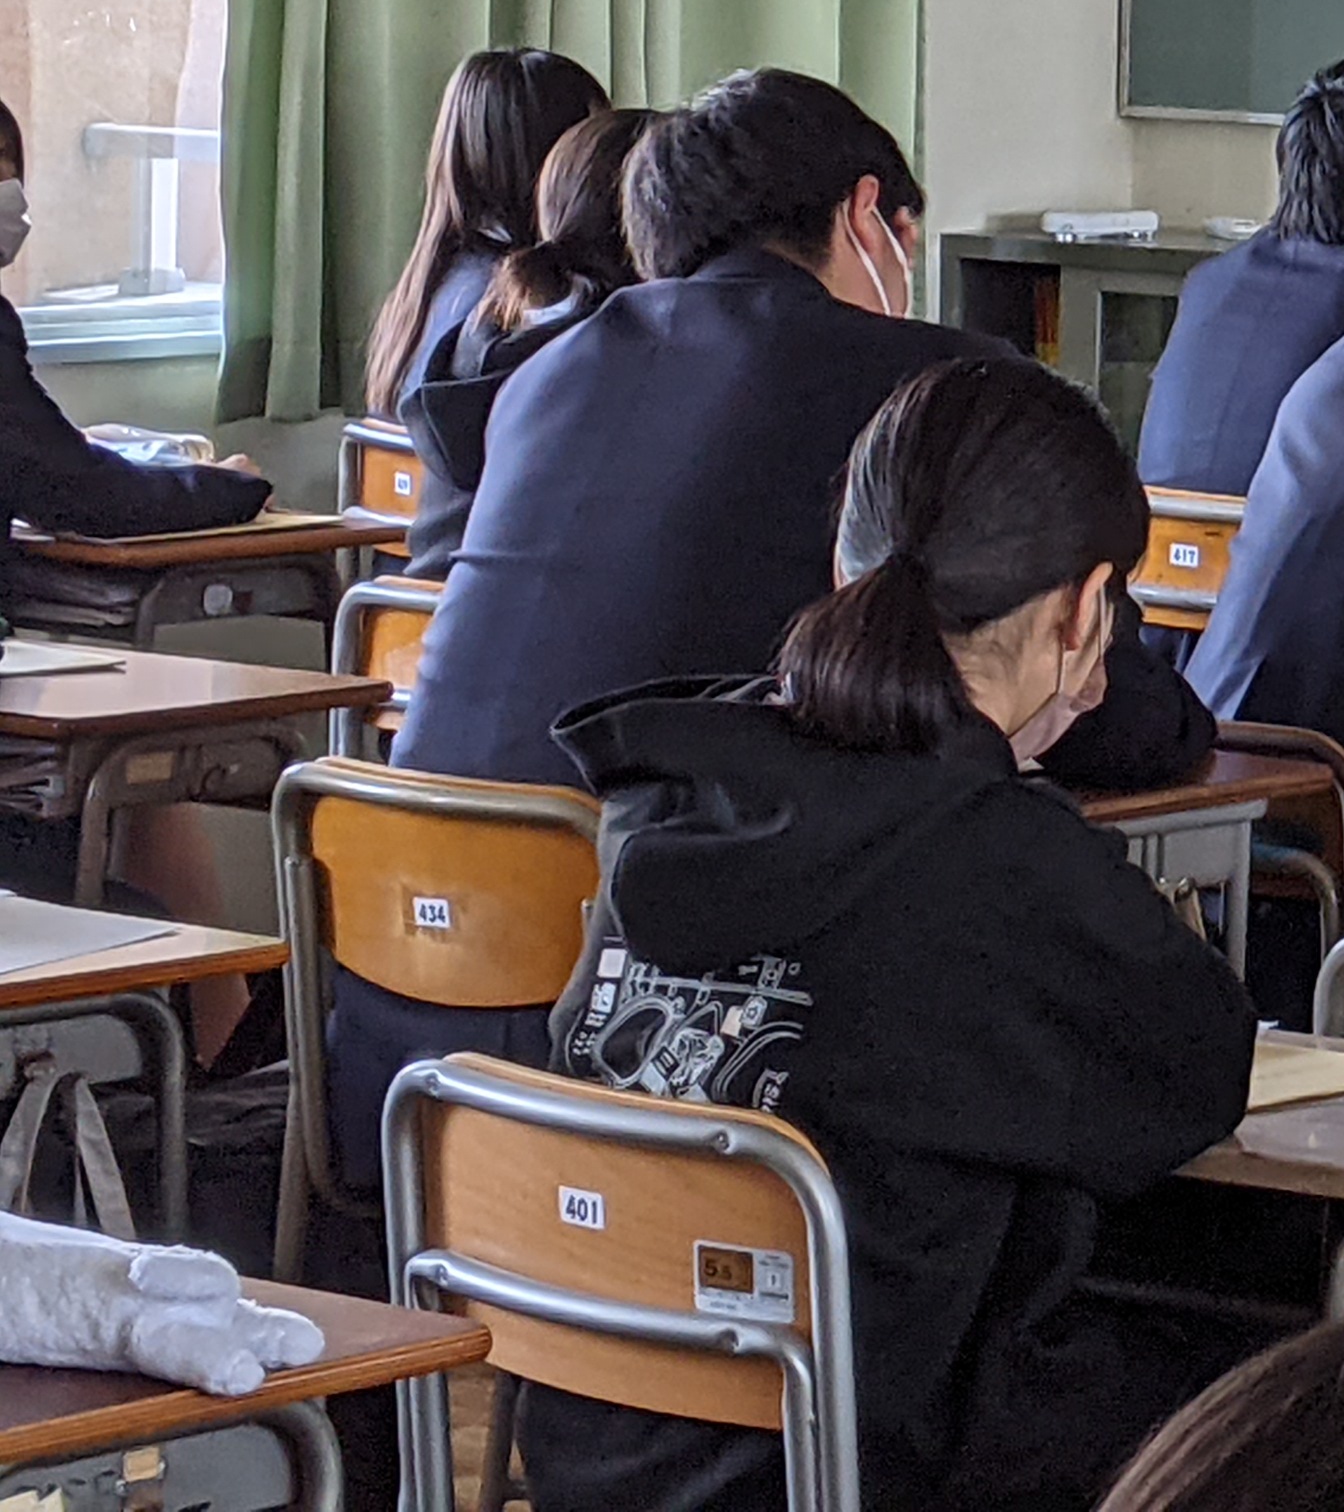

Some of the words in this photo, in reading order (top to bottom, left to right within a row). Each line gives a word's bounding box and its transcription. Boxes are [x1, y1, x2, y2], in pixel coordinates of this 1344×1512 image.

[1173, 548, 1196, 562] 417
[419, 903, 446, 923] 434
[565, 1194, 598, 1225] 401
